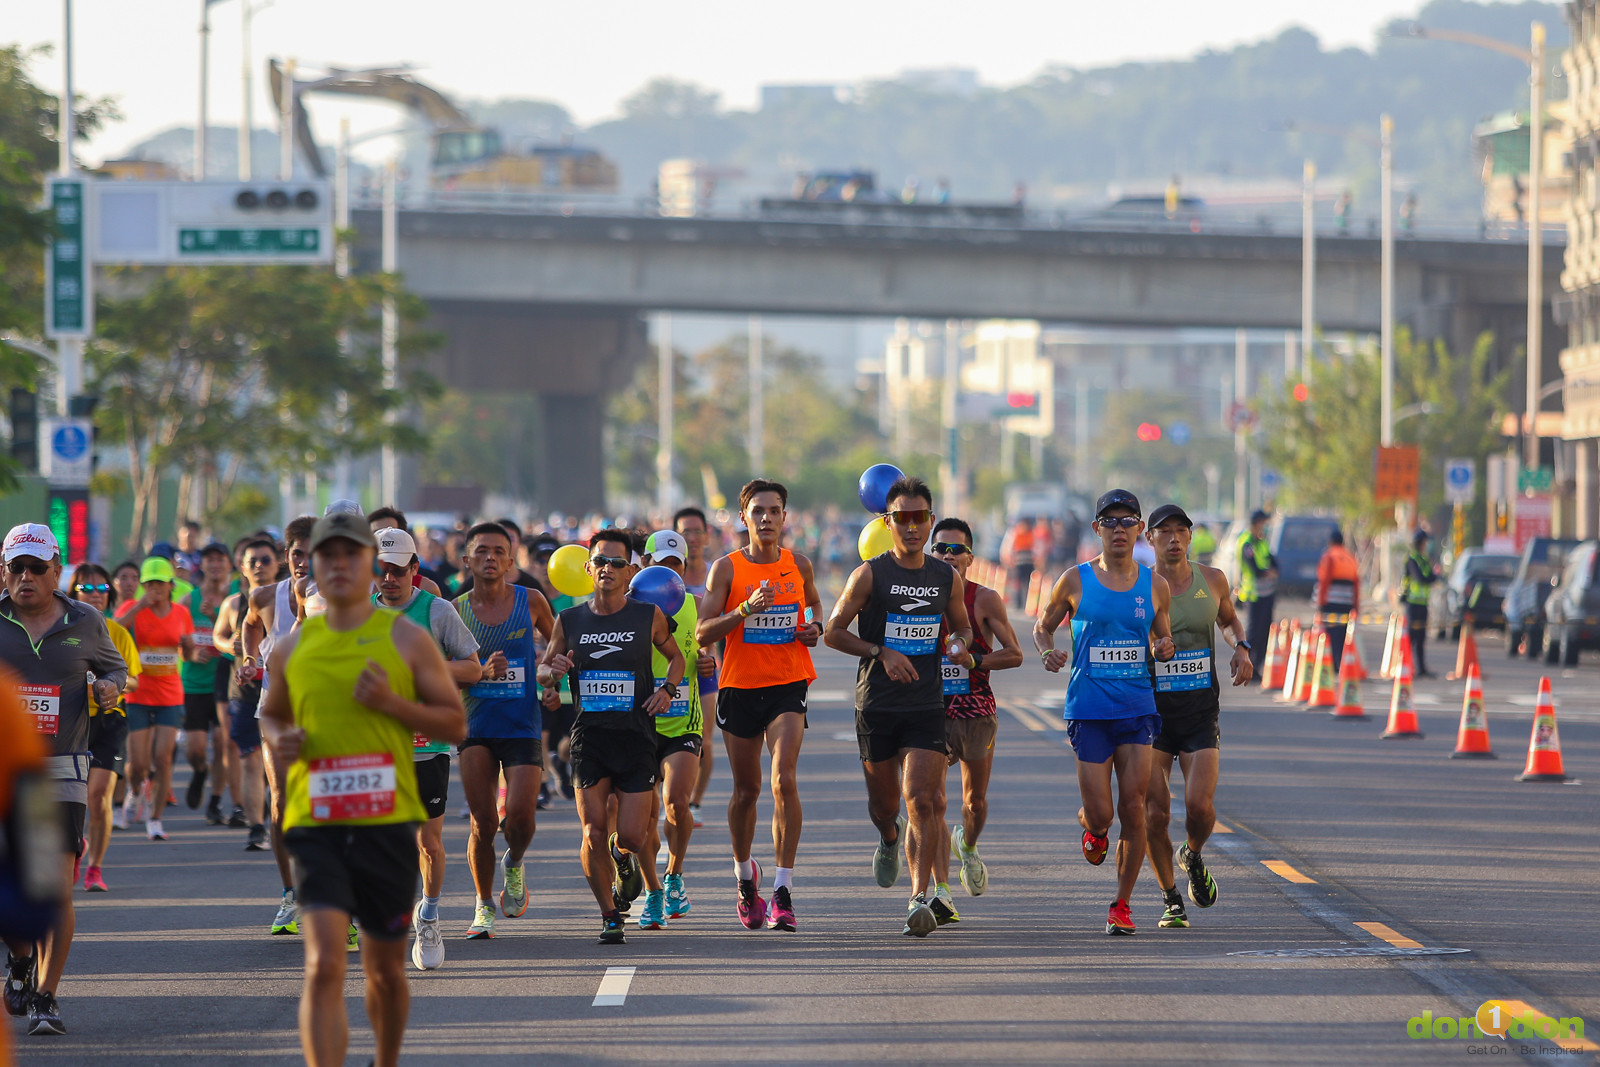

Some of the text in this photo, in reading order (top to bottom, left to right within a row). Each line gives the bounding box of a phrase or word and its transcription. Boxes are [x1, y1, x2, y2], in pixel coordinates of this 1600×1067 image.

[10, 532, 46, 547] Titleist
[890, 584, 940, 597] BROOKS
[754, 615, 792, 627] 11173
[579, 631, 636, 644] BROOKS
[894, 626, 933, 638] 11502
[1099, 650, 1138, 661] 11138
[1164, 661, 1204, 674] 11584
[586, 682, 624, 694] 11501
[320, 773, 382, 794] 32282
